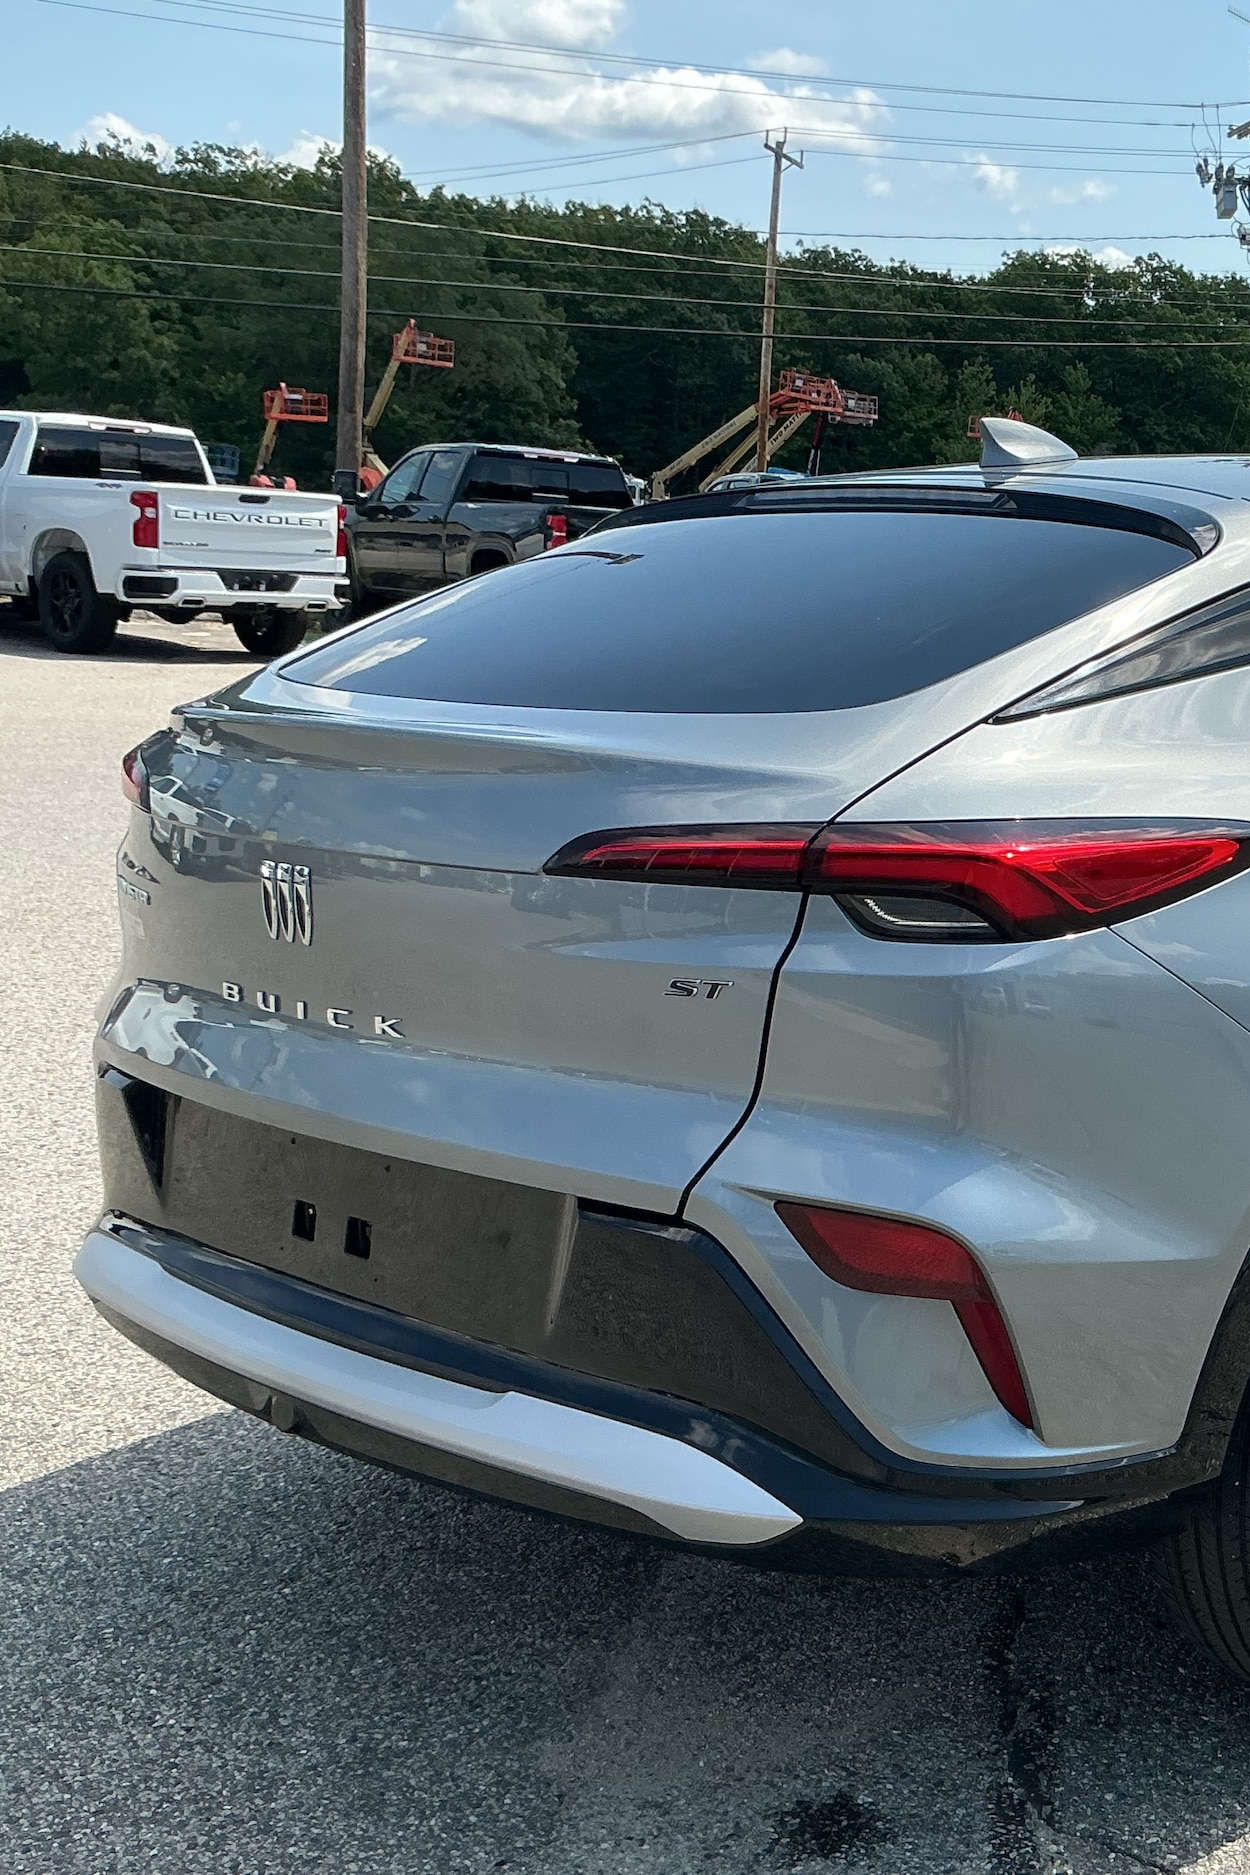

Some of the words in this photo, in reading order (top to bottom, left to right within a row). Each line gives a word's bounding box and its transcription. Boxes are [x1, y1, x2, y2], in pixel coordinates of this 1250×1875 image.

[174, 508, 328, 528] CHEVROLET
[663, 977, 735, 1000] ST
[222, 981, 406, 1039] BUICK
